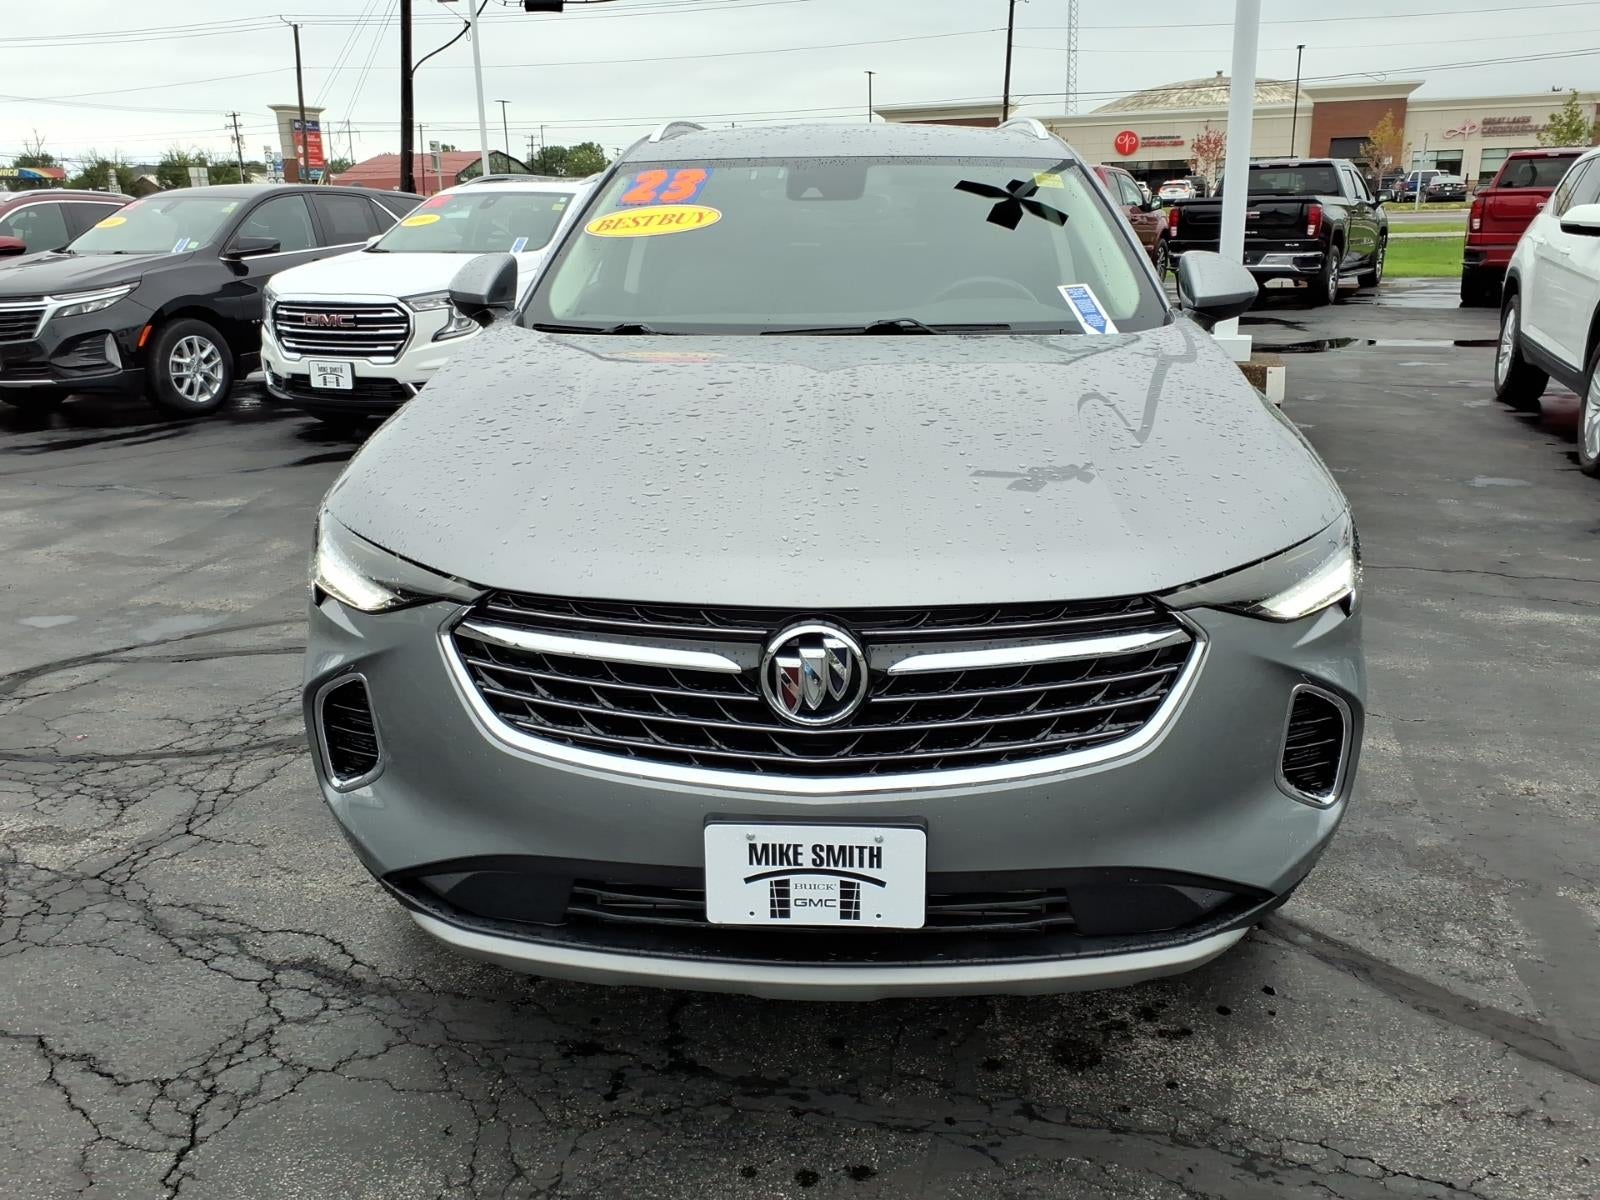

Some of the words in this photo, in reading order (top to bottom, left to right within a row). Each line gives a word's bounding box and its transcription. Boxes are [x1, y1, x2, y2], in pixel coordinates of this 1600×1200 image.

[620, 168, 707, 204] 23
[304, 313, 356, 327] GMC
[748, 842, 804, 867] MIKE
[811, 843, 882, 869] SMITH
[794, 882, 836, 890] BUICK
[793, 898, 837, 908] GMC
